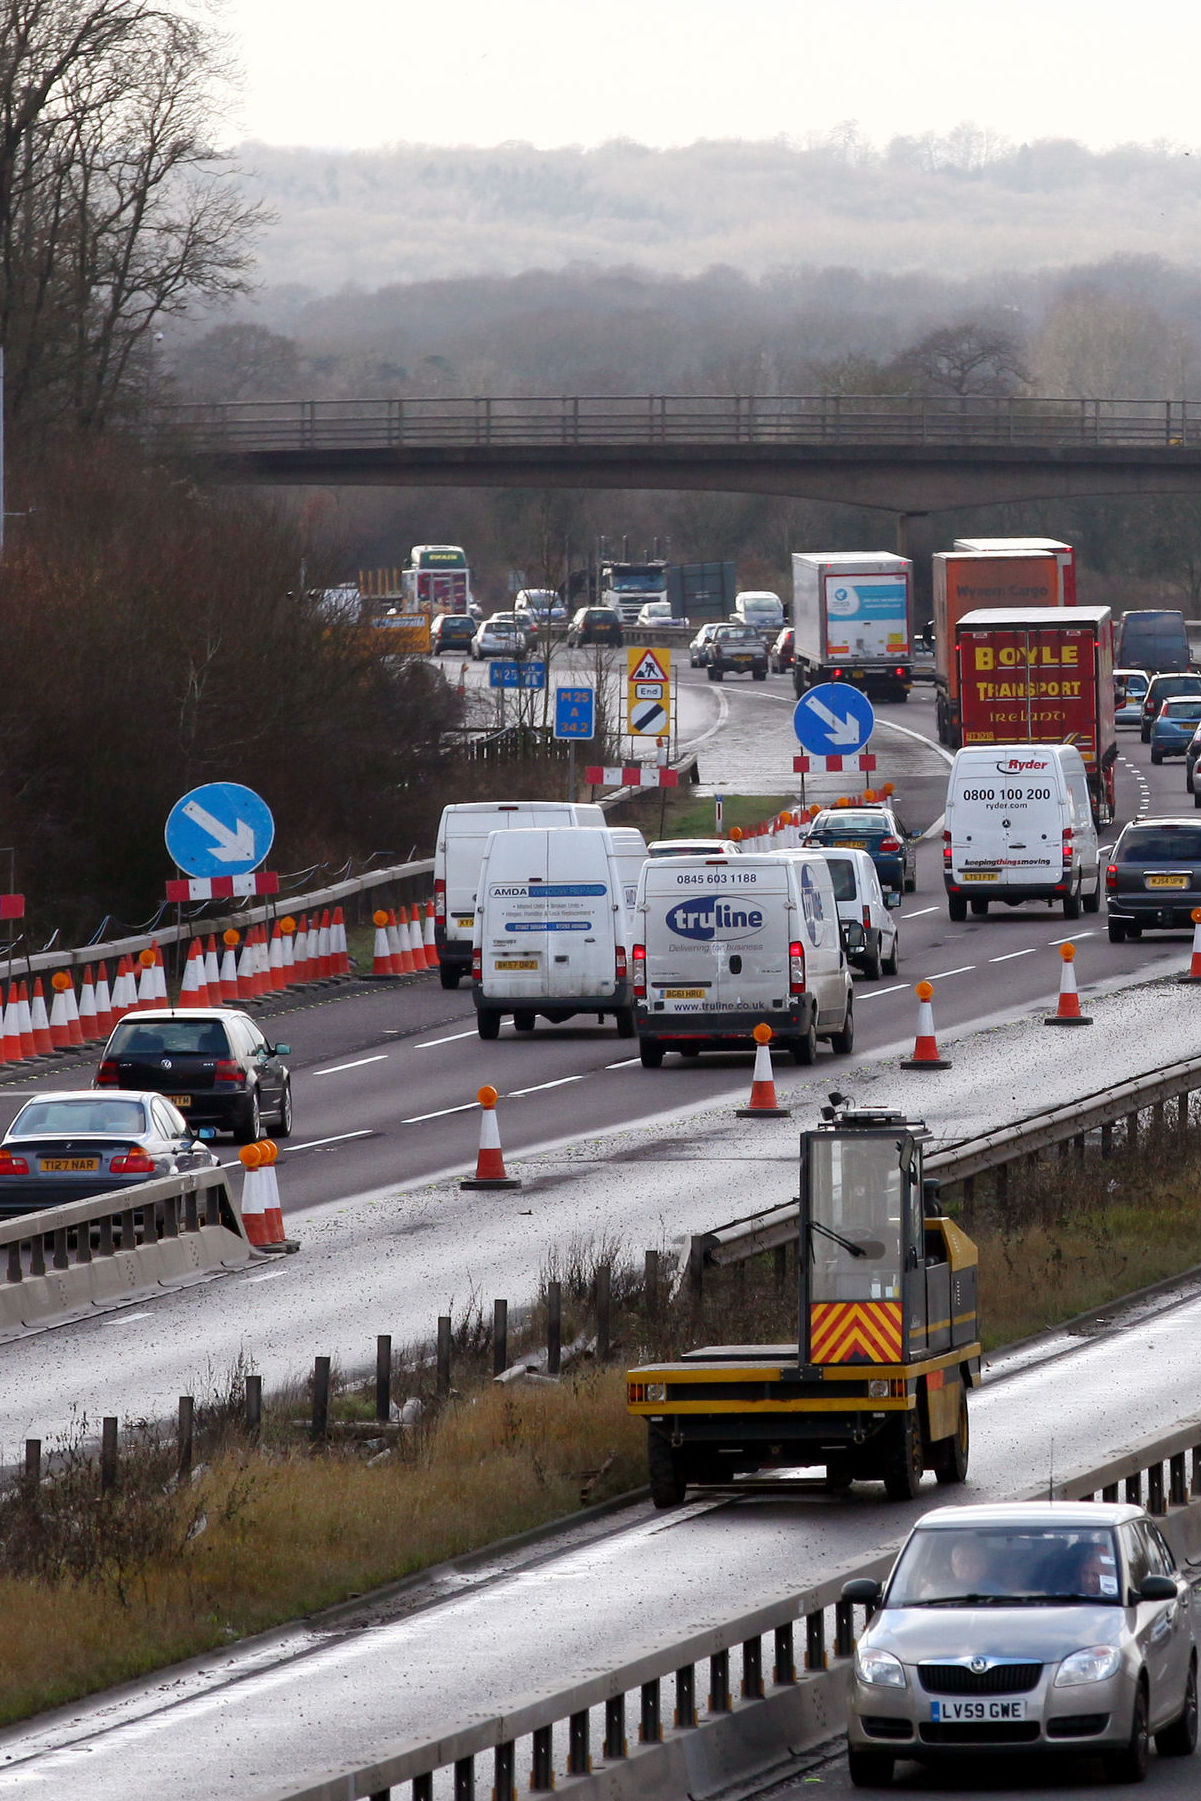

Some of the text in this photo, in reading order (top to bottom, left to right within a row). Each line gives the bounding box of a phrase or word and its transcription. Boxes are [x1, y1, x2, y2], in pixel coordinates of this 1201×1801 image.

[974, 645, 1079, 671] BOYLE
[504, 669, 518, 681] 25
[640, 687, 658, 696] End
[976, 681, 1081, 701] TRANSPORT
[560, 692, 590, 703] M 25
[570, 707, 579, 717] A
[560, 722, 589, 733] 34.2
[1008, 759, 1048, 771] Ryder
[963, 788, 1051, 801] 0800 100 200
[985, 802, 1028, 811] ryder.com
[676, 873, 757, 884] 0845 603 1188
[493, 888, 527, 896] AMDA
[674, 905, 763, 928] truline
[668, 943, 710, 953] Delivering
[726, 943, 764, 951] business
[674, 1001, 766, 1011] www.truline.co.uk
[44, 1160, 94, 1170] T127 NAR
[942, 1702, 1022, 1719] LV59 GWE
